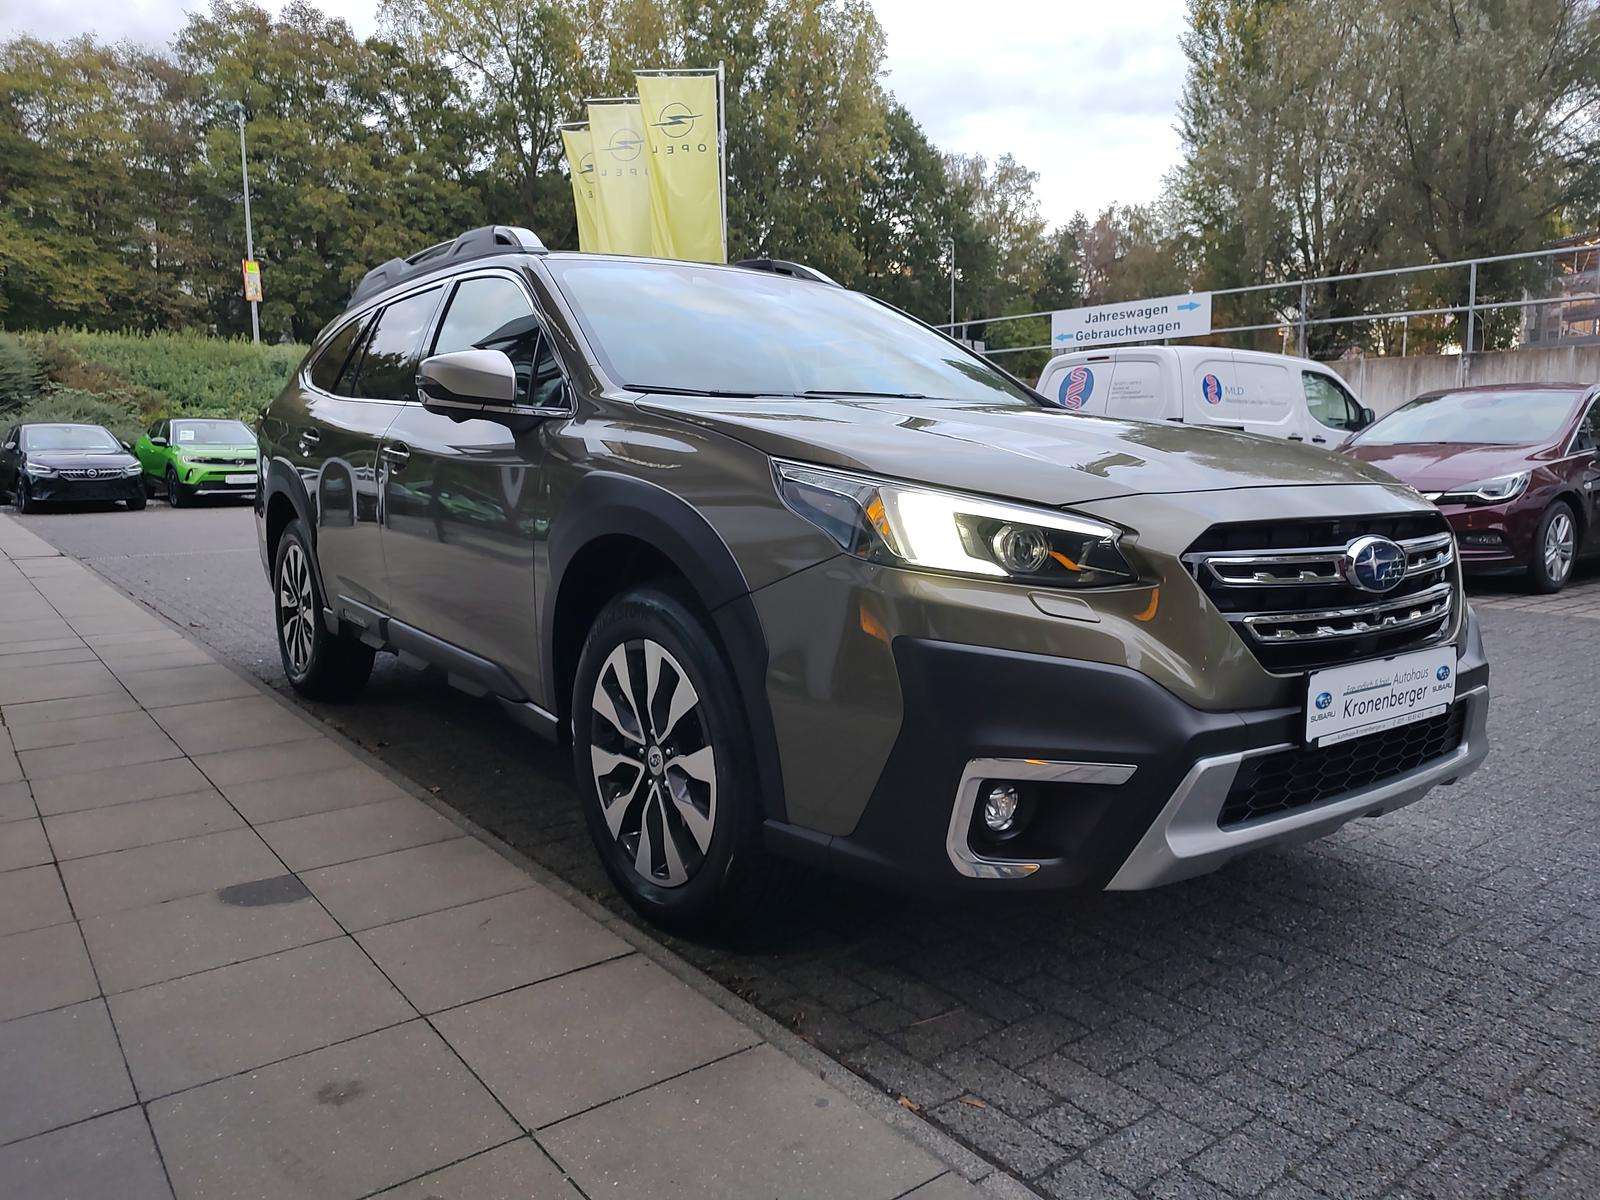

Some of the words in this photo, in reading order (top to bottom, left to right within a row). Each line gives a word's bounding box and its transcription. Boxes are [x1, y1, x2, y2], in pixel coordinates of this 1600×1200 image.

[1085, 305, 1168, 324] Jahreswagen
[1075, 321, 1181, 342] Gebrauchtwagen
[1393, 668, 1429, 686] Autohaus
[1432, 683, 1453, 693] SUBARU
[1343, 685, 1428, 719] Kronenberger
[1310, 711, 1336, 723] SUBARU
